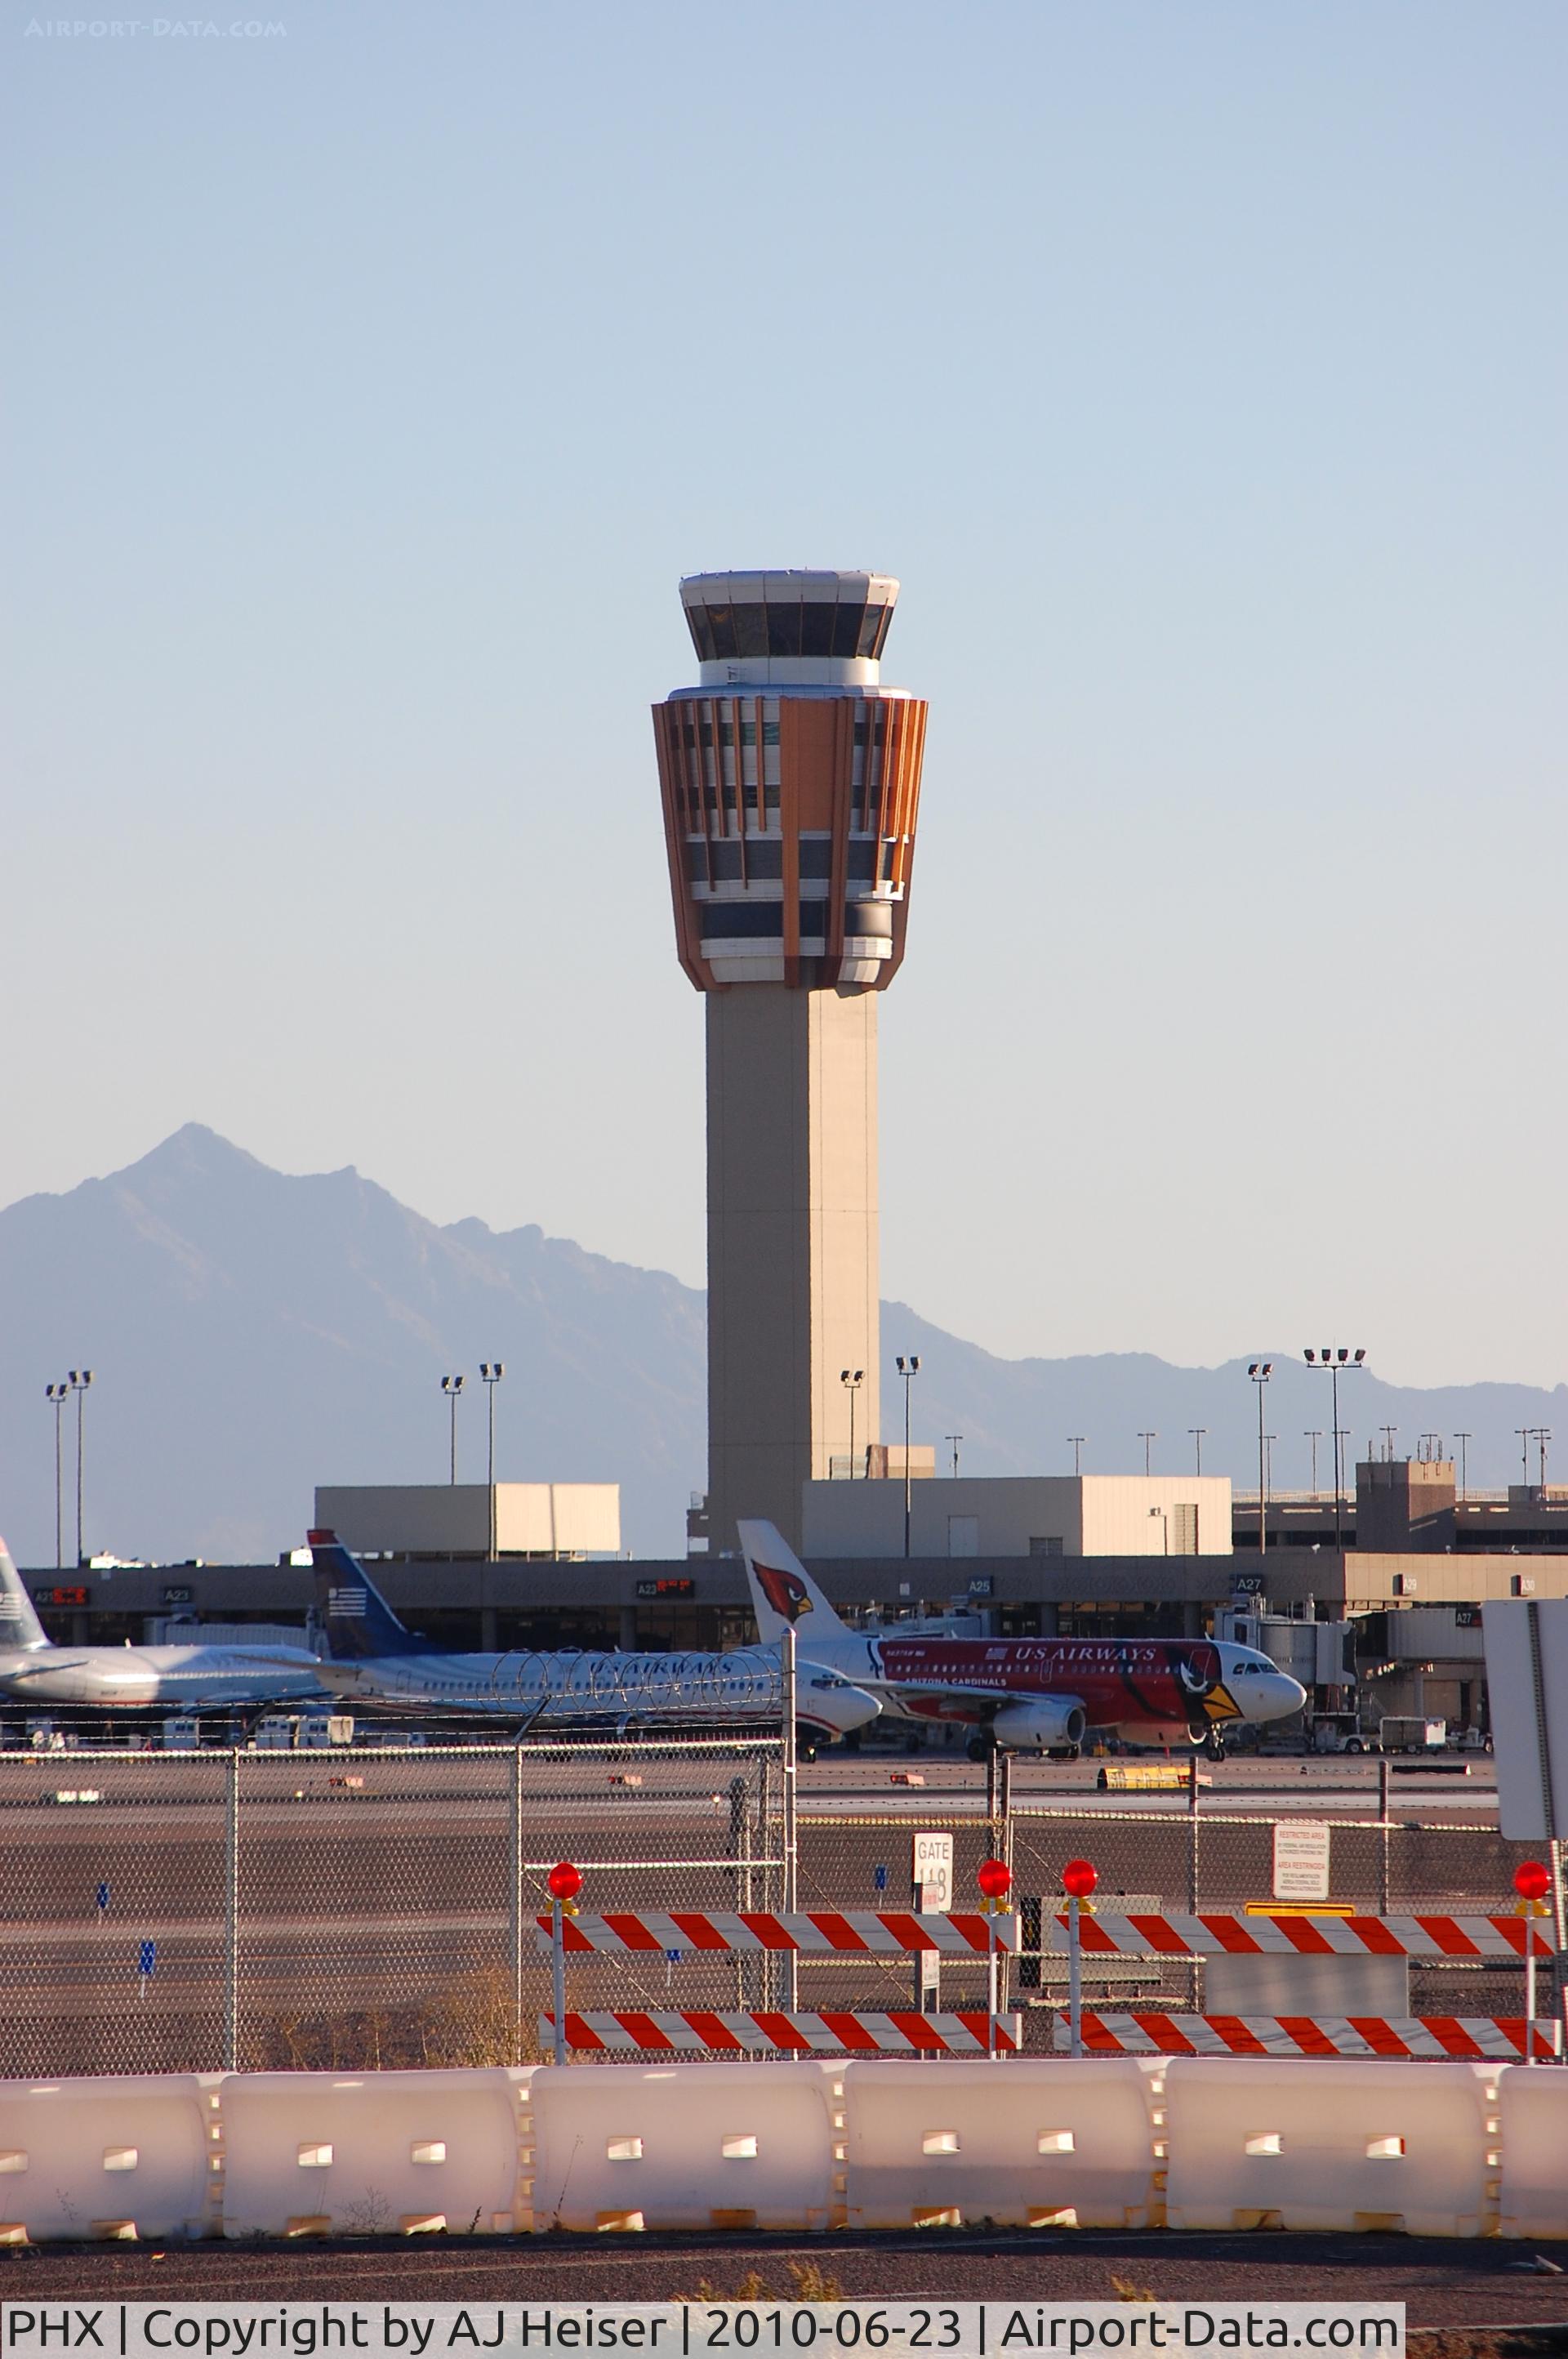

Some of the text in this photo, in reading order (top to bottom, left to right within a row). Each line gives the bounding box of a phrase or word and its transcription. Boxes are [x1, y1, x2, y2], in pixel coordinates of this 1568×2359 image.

[639, 1583, 657, 1594] A23
[969, 1580, 990, 1592] A25
[1237, 1578, 1262, 1590] A27
[1403, 1578, 1417, 1590] A29
[1521, 1579, 1535, 1591] A30
[165, 1589, 189, 1601] A23
[1457, 1612, 1472, 1624] A27
[1052, 1647, 1156, 1661] AIRWAYS
[626, 1661, 733, 1674] AIRWAYS
[951, 1678, 1007, 1687] CARDINALS
[1279, 1831, 1310, 1839] RESTRICTED
[918, 1841, 949, 1860] GATE
